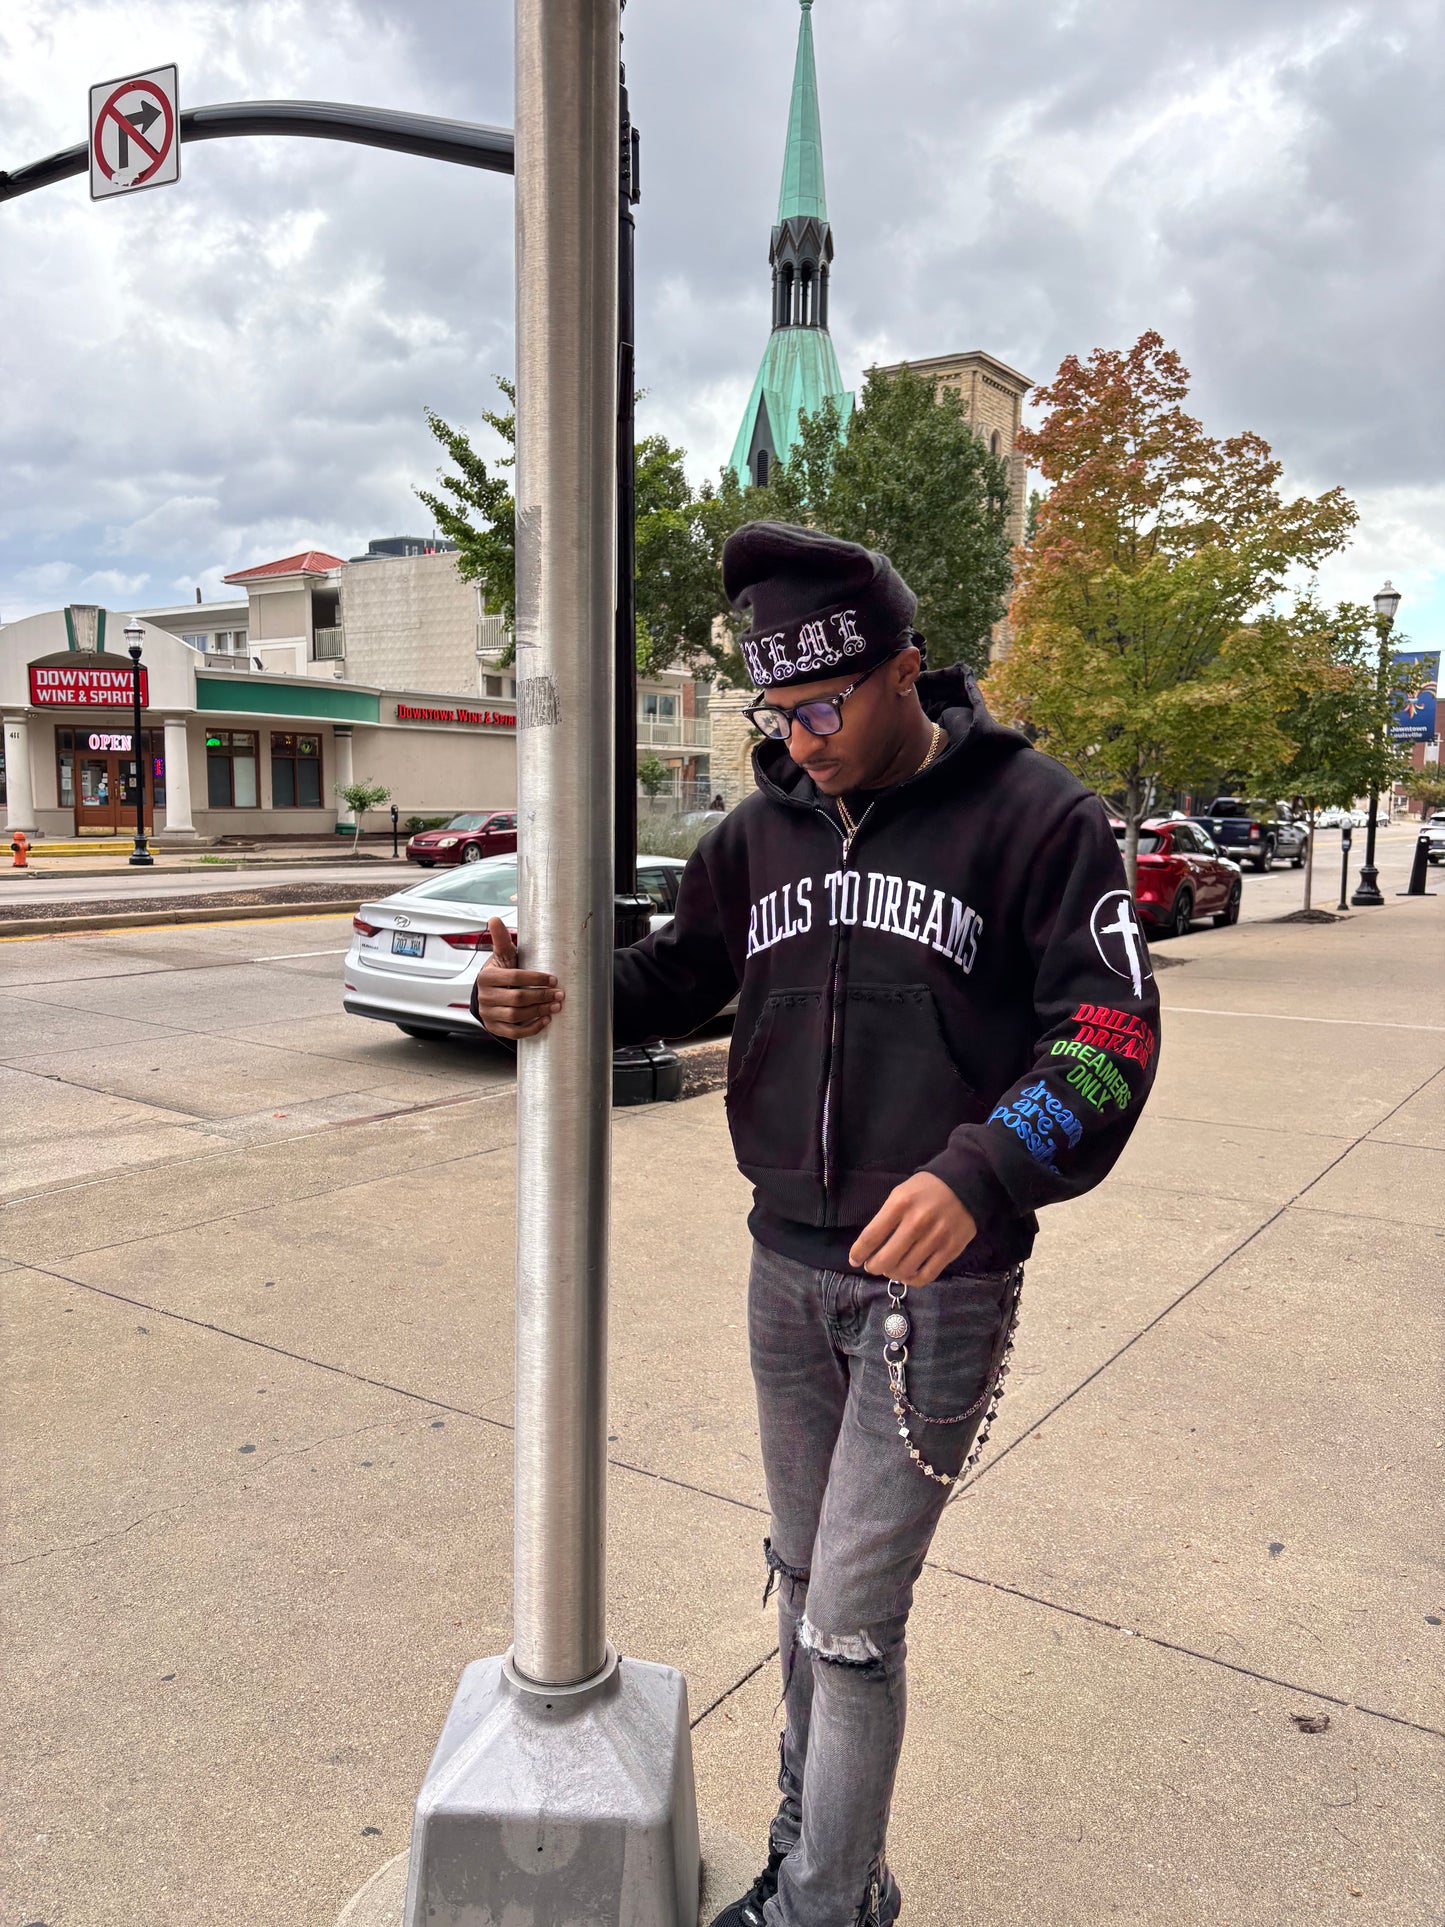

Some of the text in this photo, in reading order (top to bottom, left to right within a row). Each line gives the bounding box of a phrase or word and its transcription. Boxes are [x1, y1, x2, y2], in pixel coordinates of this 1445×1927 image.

[740, 609, 867, 685] REME
[36, 689, 76, 703] WINE
[78, 690, 87, 703] &
[397, 704, 516, 726] DOWNTOWN WINE & SPIRI
[88, 733, 132, 751] OPEN
[746, 870, 984, 975] RILLS TO DREAMS
[1071, 1003, 1147, 1040] DRILLS
[1050, 1040, 1132, 1110] DREAMERS
[1012, 1098, 1054, 1135] are
